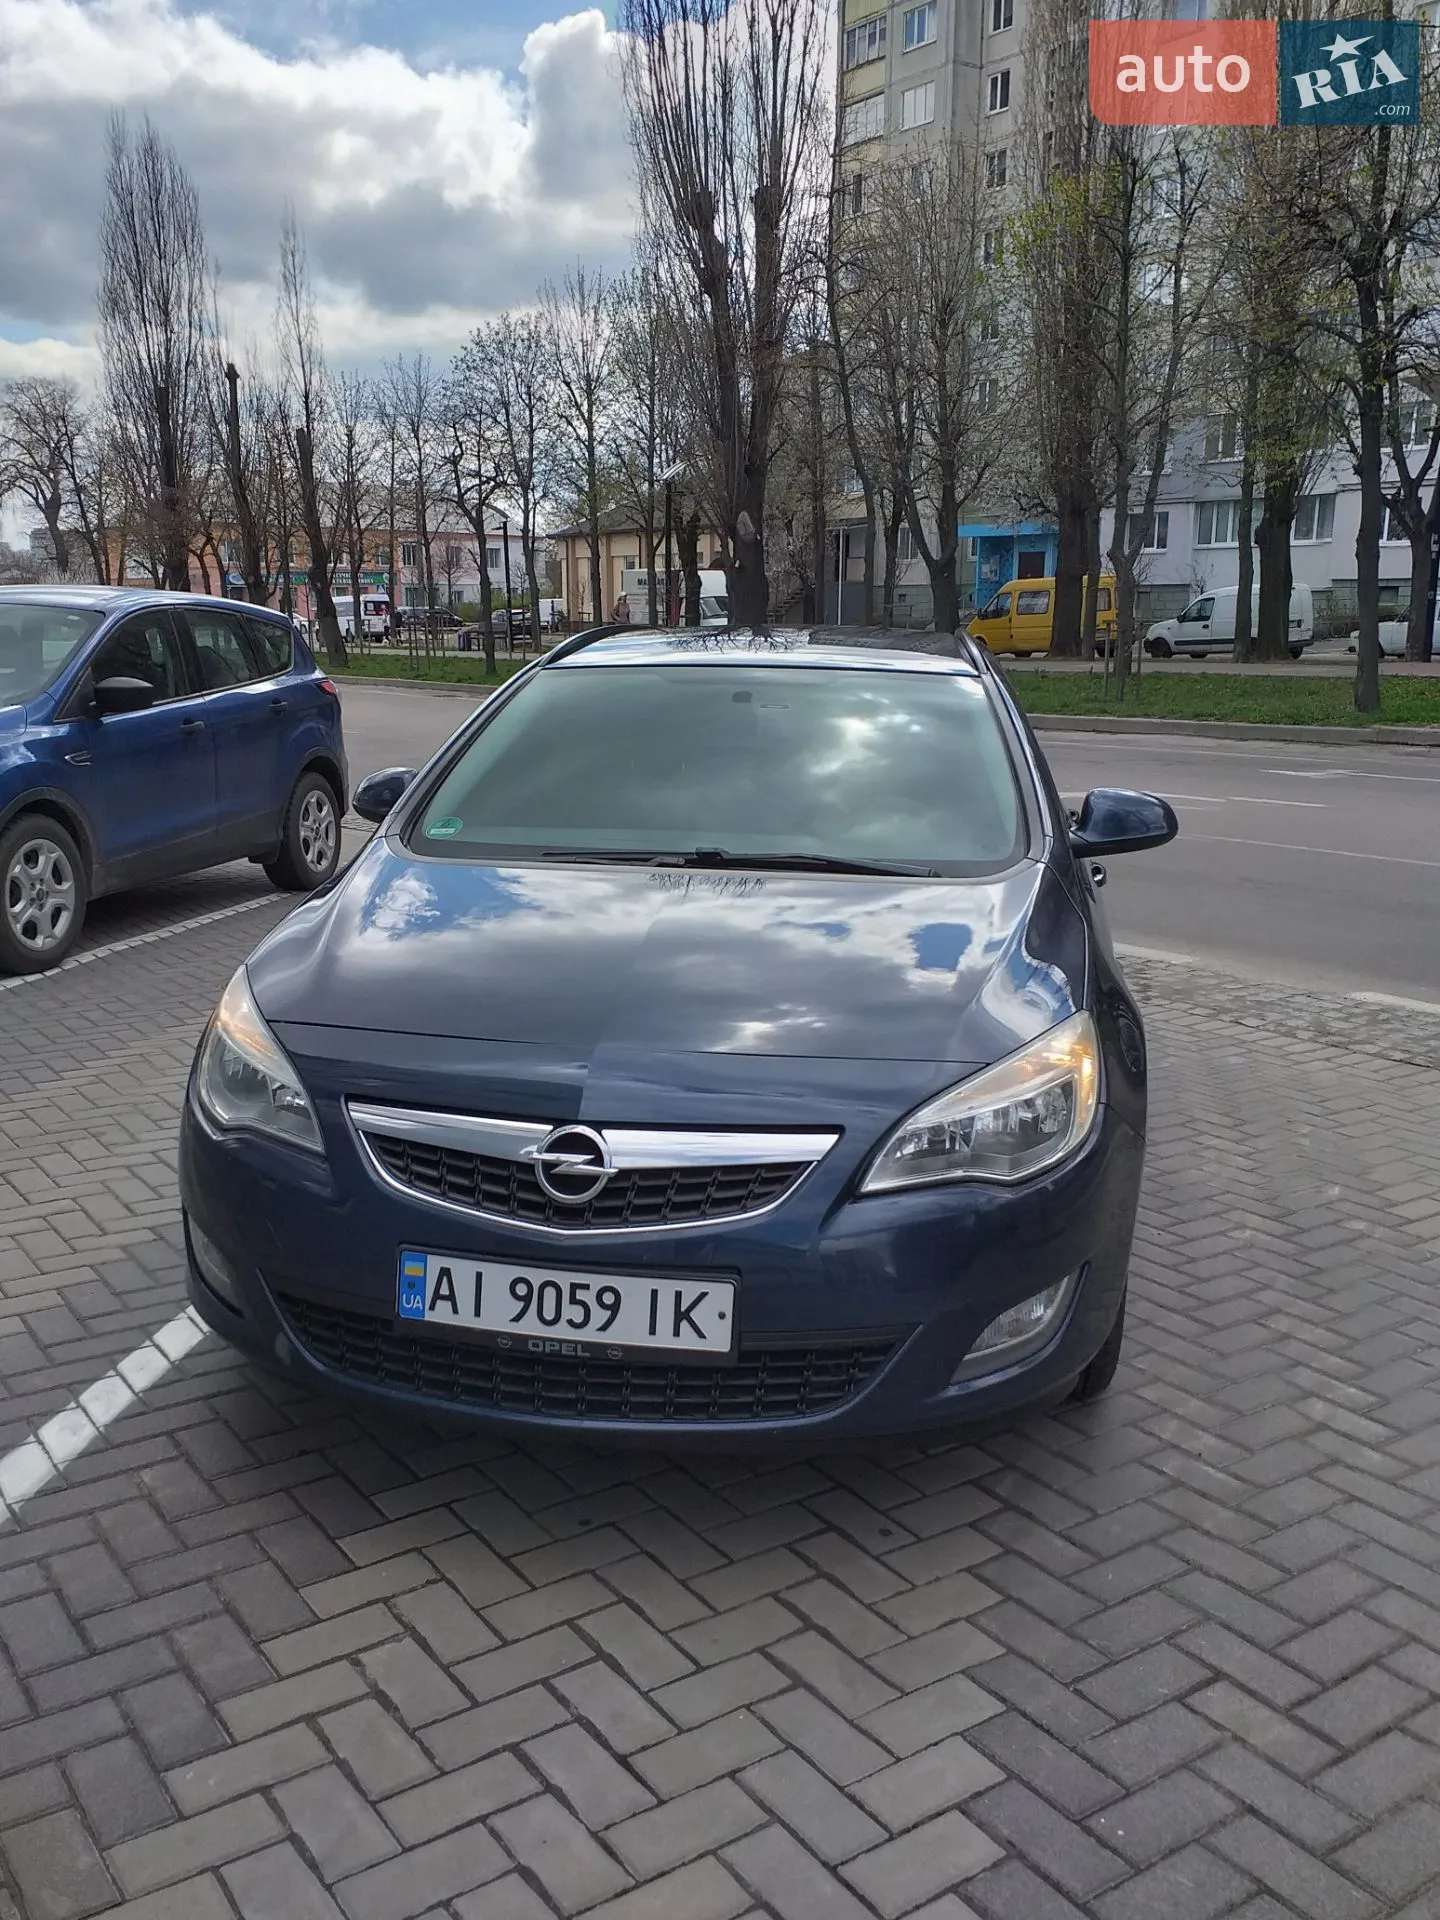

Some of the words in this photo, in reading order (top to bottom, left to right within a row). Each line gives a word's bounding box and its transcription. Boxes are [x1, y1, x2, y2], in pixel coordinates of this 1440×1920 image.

[402, 1293, 423, 1310] UA
[428, 1266, 483, 1317] AI
[509, 1276, 622, 1332] 9059
[649, 1288, 709, 1339] IK
[528, 1339, 590, 1357] OPEL
